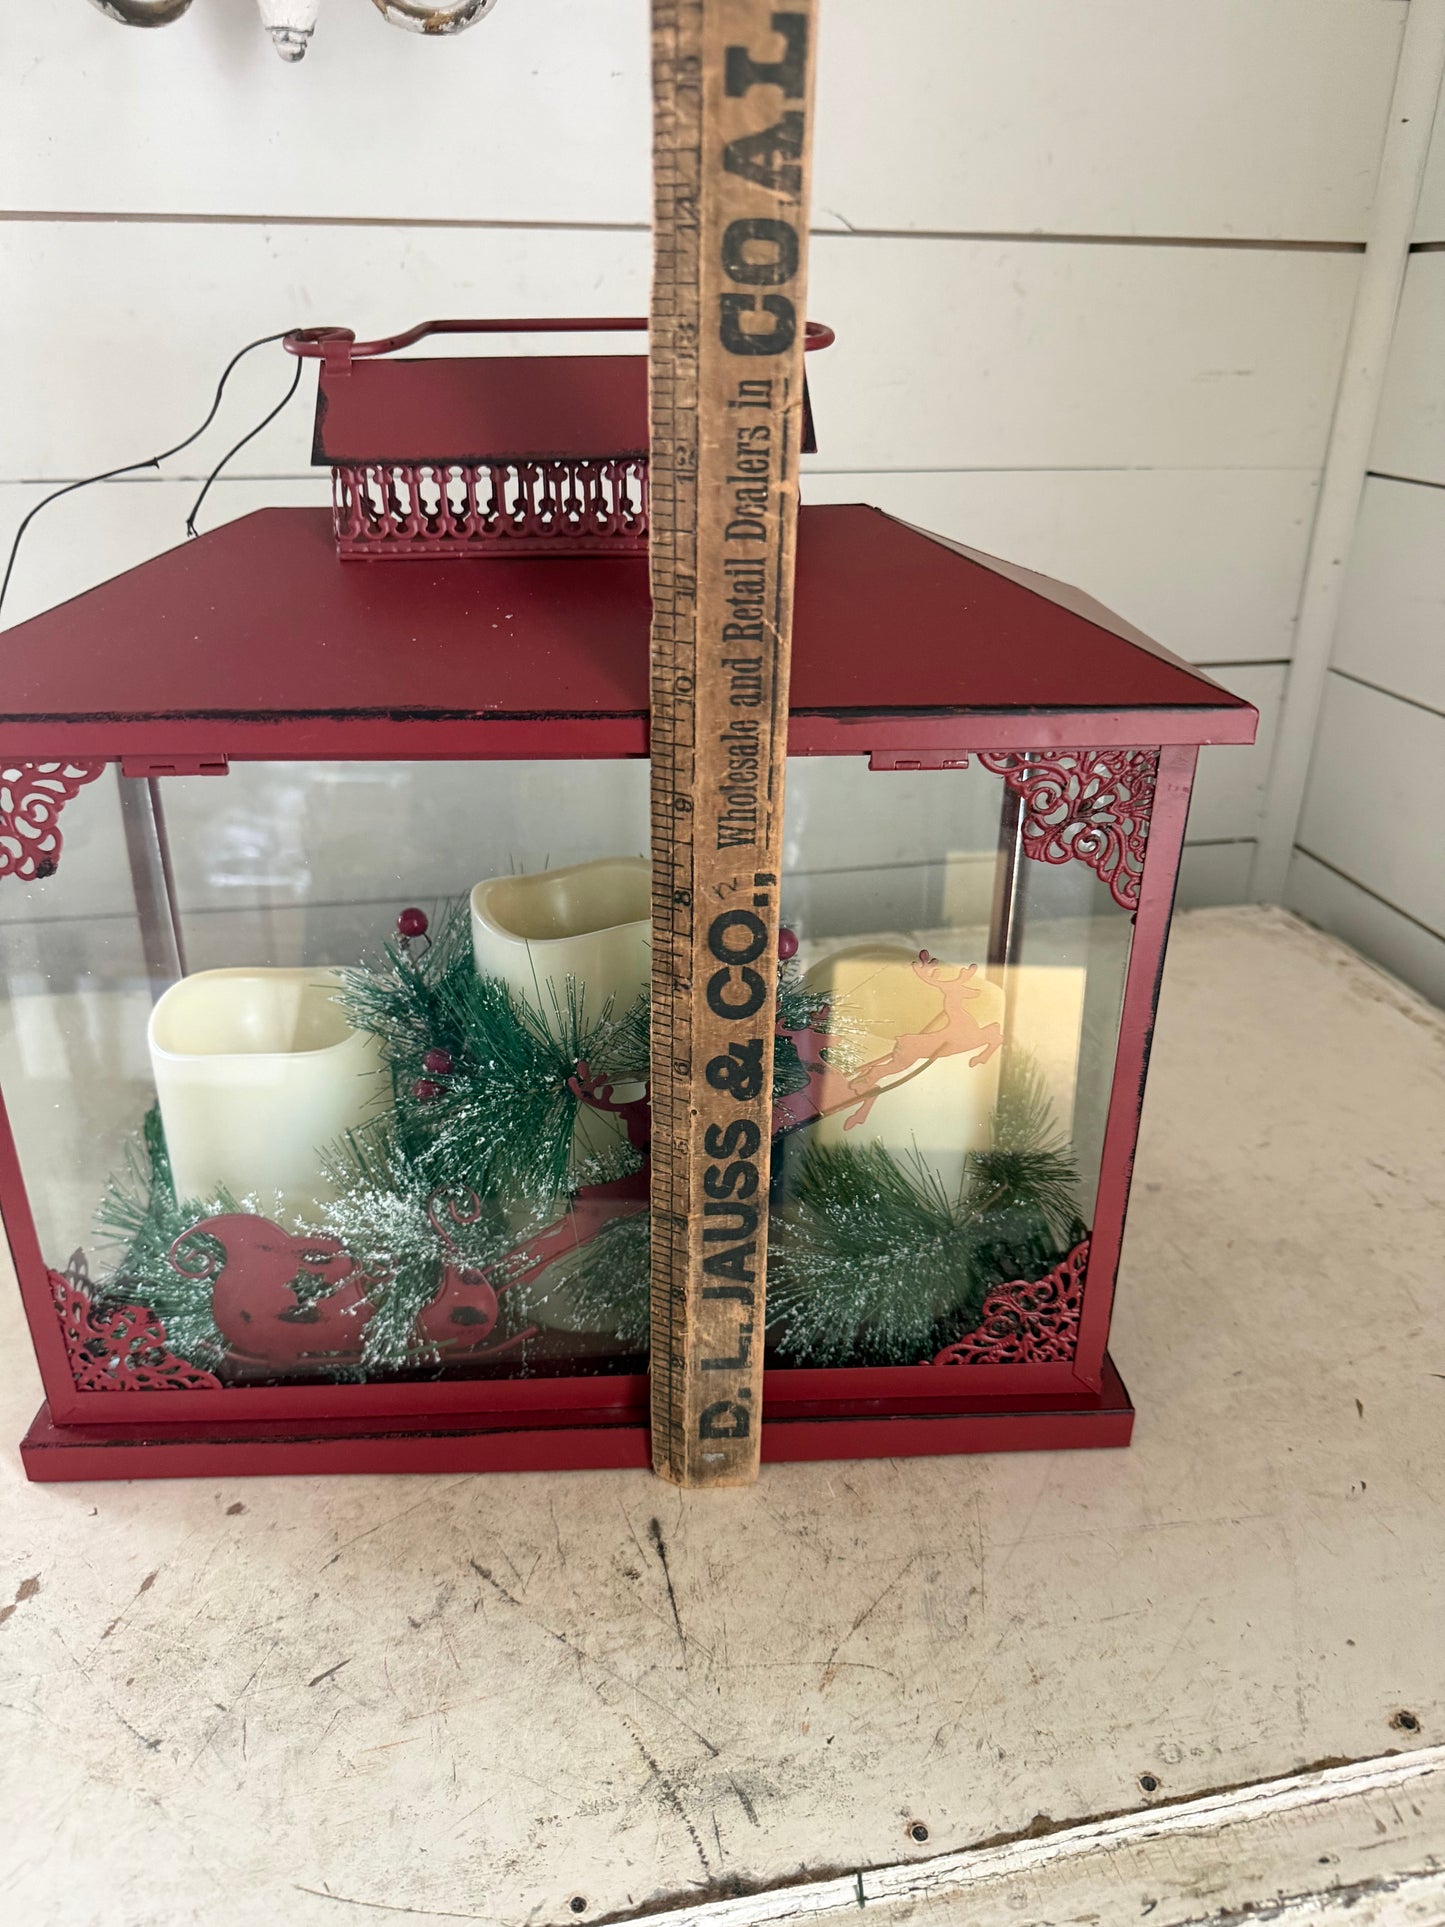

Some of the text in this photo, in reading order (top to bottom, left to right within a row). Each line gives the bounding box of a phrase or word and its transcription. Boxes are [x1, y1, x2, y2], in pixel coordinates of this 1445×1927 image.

[720, 12, 808, 356] COAL
[727, 379, 773, 409] in
[724, 425, 771, 543] Dealers
[675, 574, 695, 600] 11
[722, 558, 766, 642] Retail
[675, 675, 693, 705] 10
[721, 655, 763, 707] and
[674, 797, 693, 813] 9
[717, 720, 760, 850] Wholesale
[673, 890, 693, 907] 8
[673, 977, 692, 992] 7
[673, 1060, 691, 1077] 6
[705, 1039, 764, 1101] &
[673, 1139, 689, 1155] 5
[703, 1119, 761, 1305] JAUSS
[700, 1323, 753, 1371] L.
[699, 1387, 752, 1439] D.
